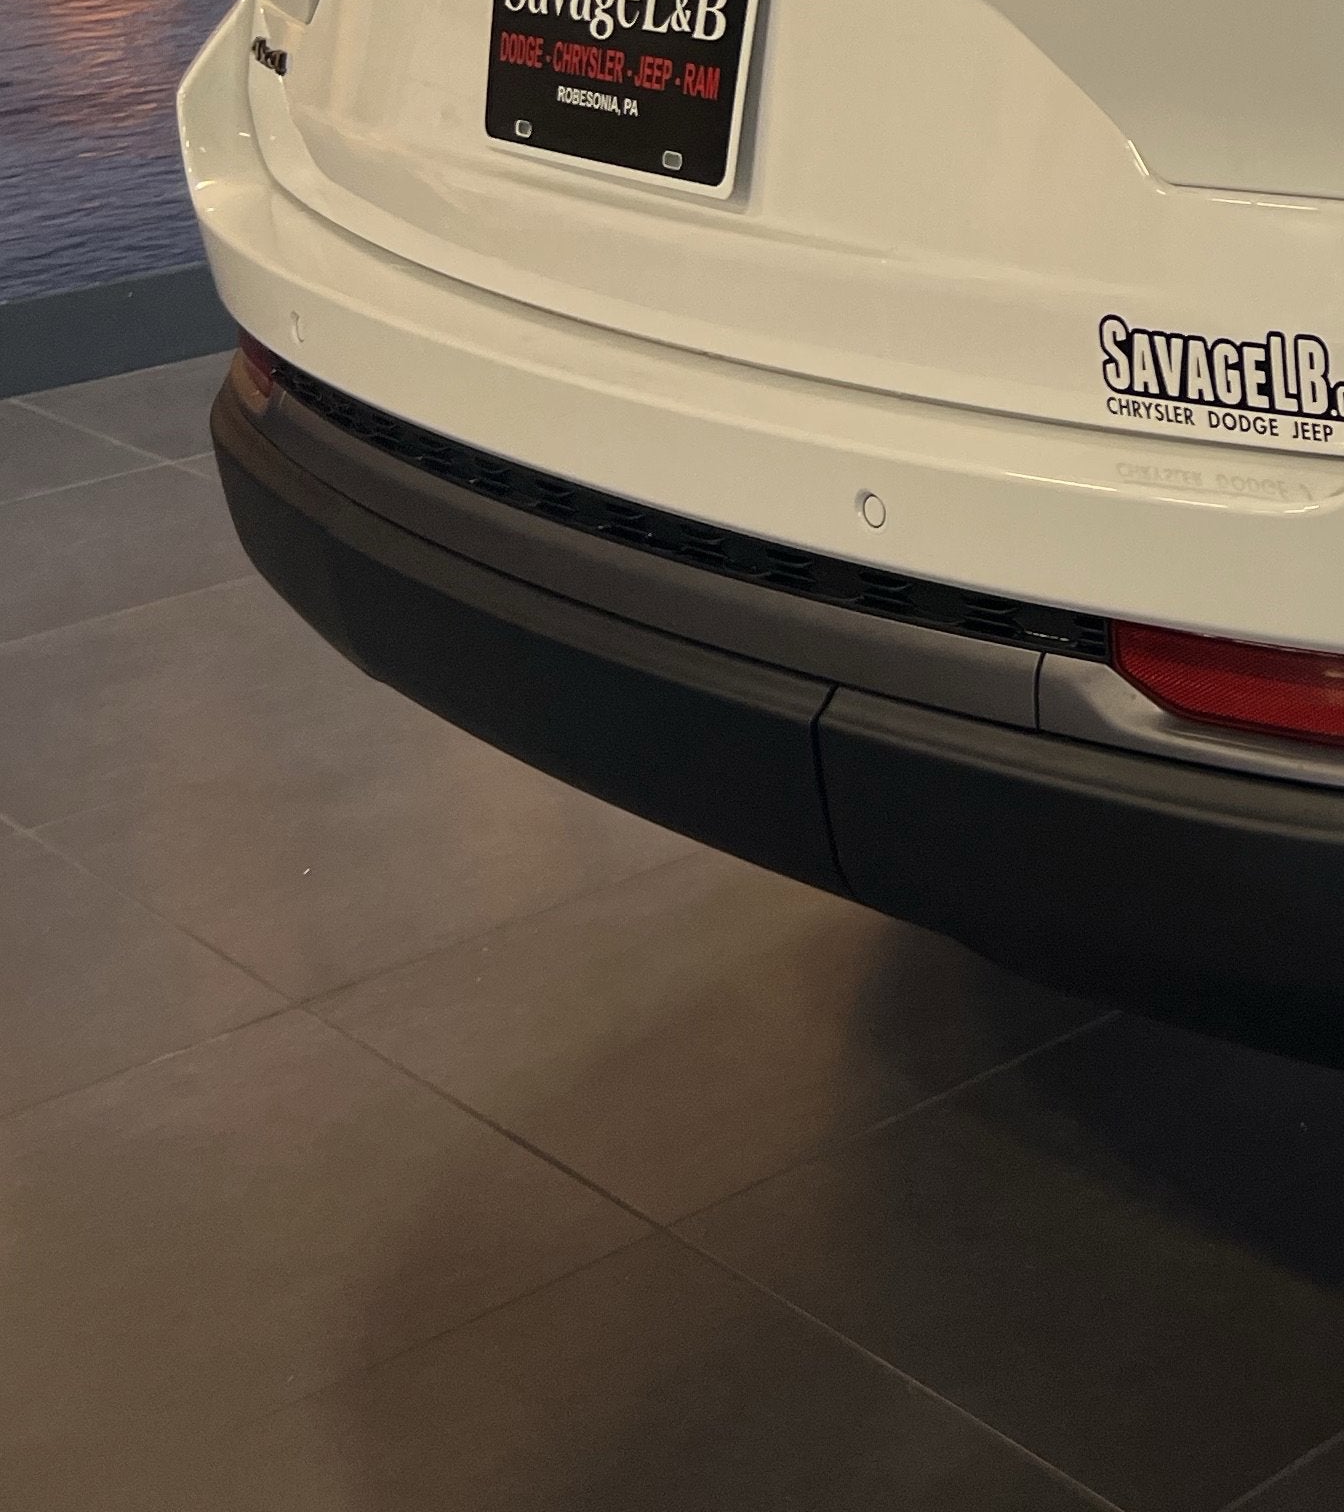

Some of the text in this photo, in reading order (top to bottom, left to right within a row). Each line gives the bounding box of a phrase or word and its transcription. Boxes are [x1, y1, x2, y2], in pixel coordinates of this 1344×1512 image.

[500, 31, 721, 102] DODGE CHRYSLER JEEP RAM
[557, 86, 639, 118] ROBESONIA, PA
[1106, 396, 1196, 426] CHRYSLER
[1208, 410, 1280, 437] DODGE
[1292, 420, 1334, 443] JEEP
